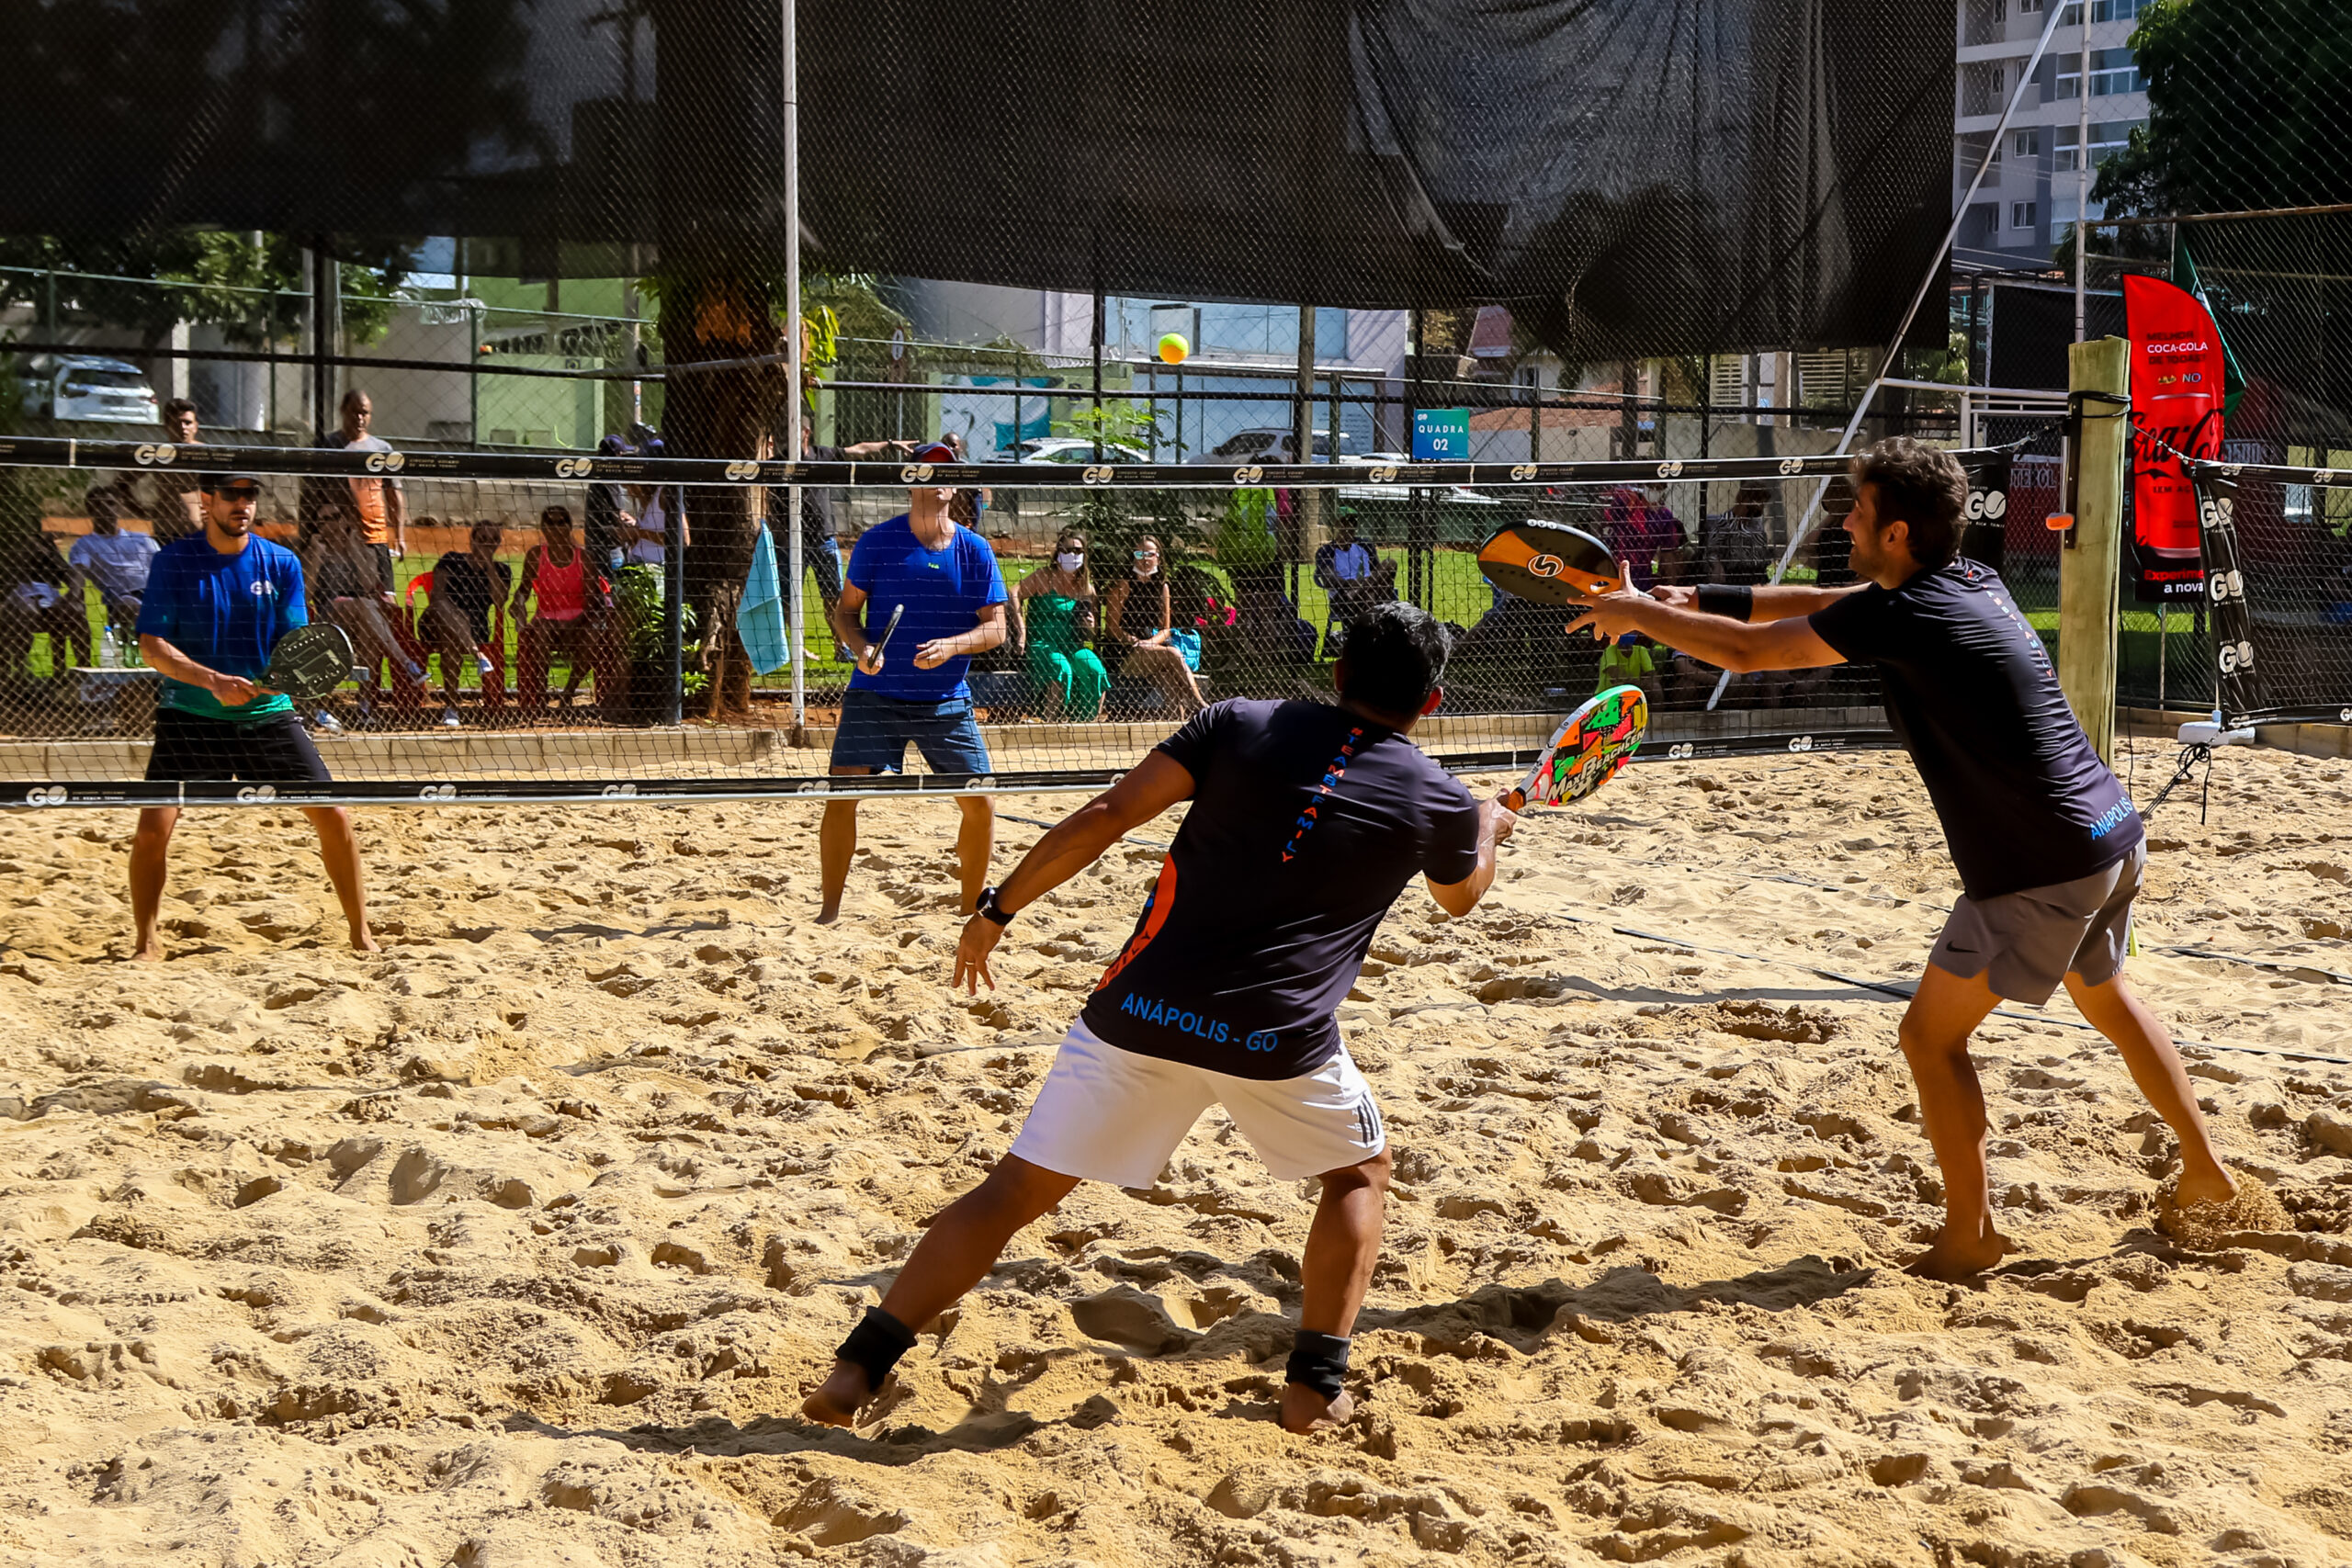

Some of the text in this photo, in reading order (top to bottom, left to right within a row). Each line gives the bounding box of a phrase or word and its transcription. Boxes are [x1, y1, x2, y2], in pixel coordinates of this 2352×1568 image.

[1419, 424, 1464, 434] QUADRA
[1433, 438, 1449, 451] 02
[1964, 491, 2007, 520] GO
[2164, 584, 2173, 593] a
[2089, 796, 2133, 840] ANÁPOLIS
[1121, 992, 1229, 1043] ANÁPOLIS
[1246, 1031, 1278, 1052] GO
